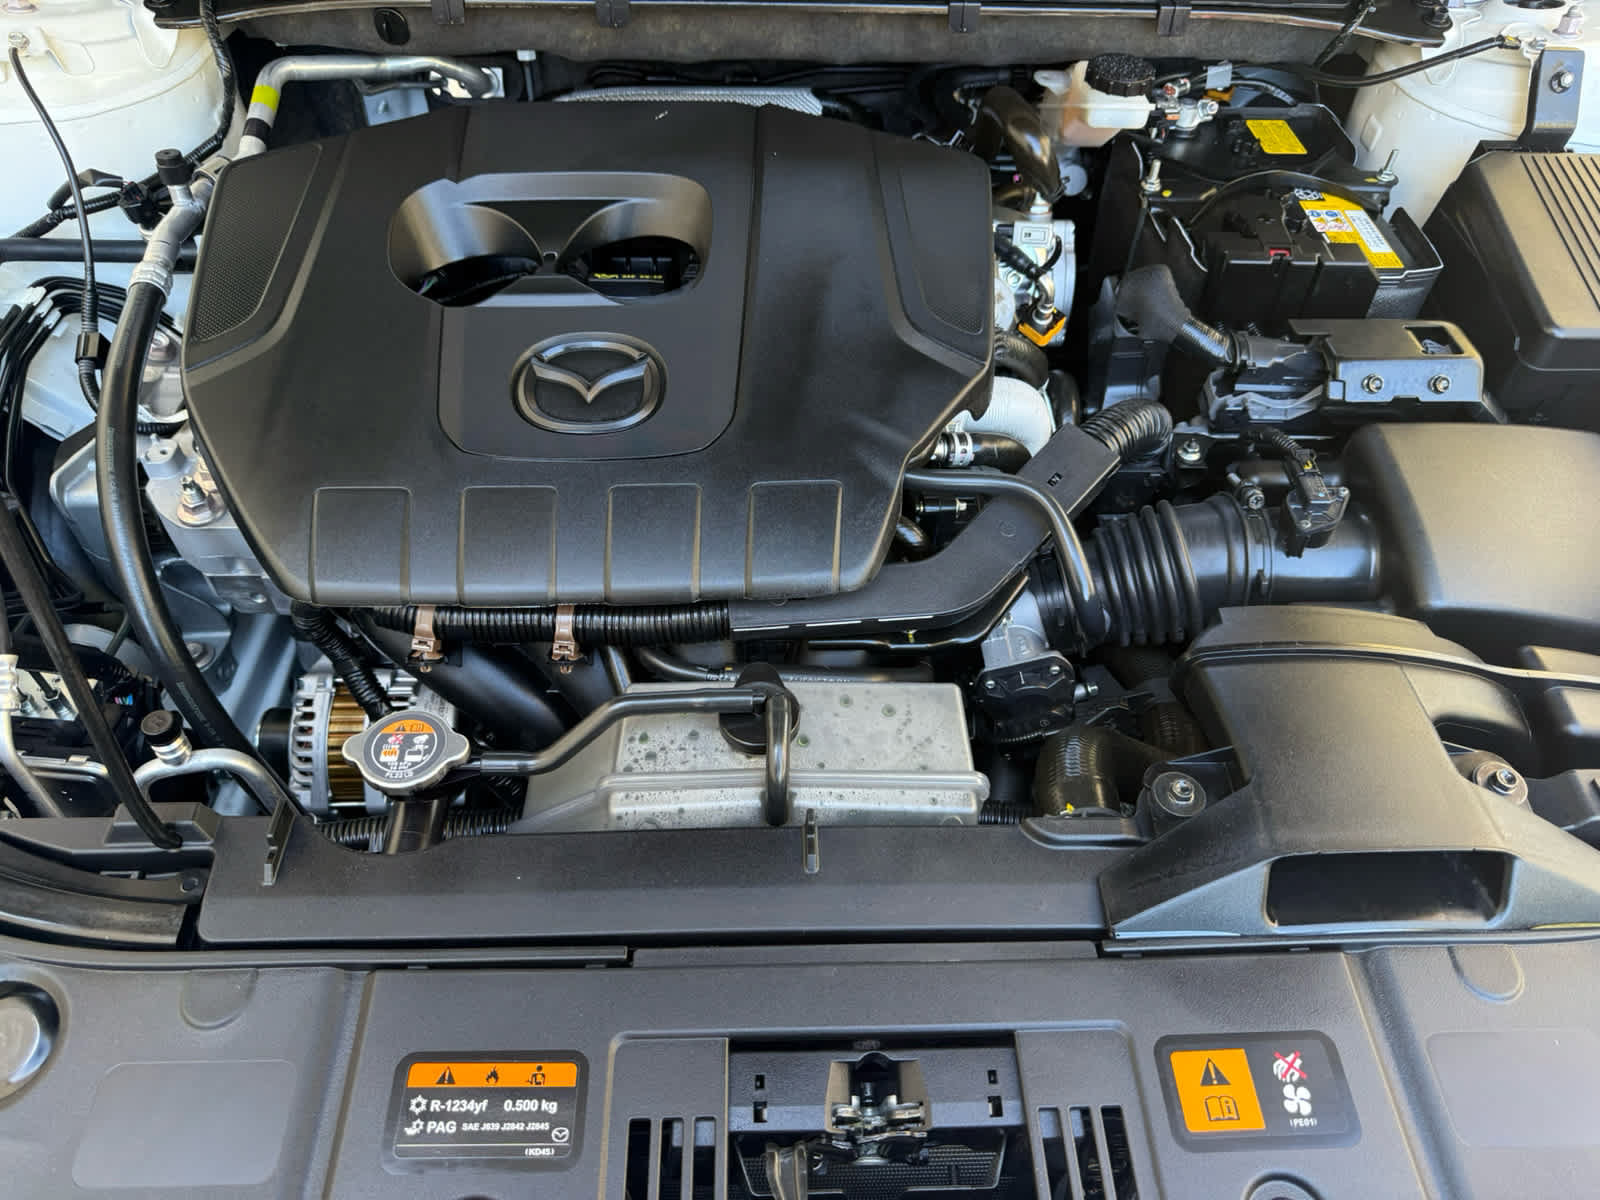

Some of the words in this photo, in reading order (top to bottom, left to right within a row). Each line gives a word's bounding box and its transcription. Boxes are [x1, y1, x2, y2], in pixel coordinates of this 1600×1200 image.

[429, 1098, 489, 1116] R-1234yf
[503, 1098, 539, 1113] 0.500
[540, 1098, 558, 1115] kg
[426, 1120, 457, 1134] PAG
[461, 1121, 480, 1132] SAE
